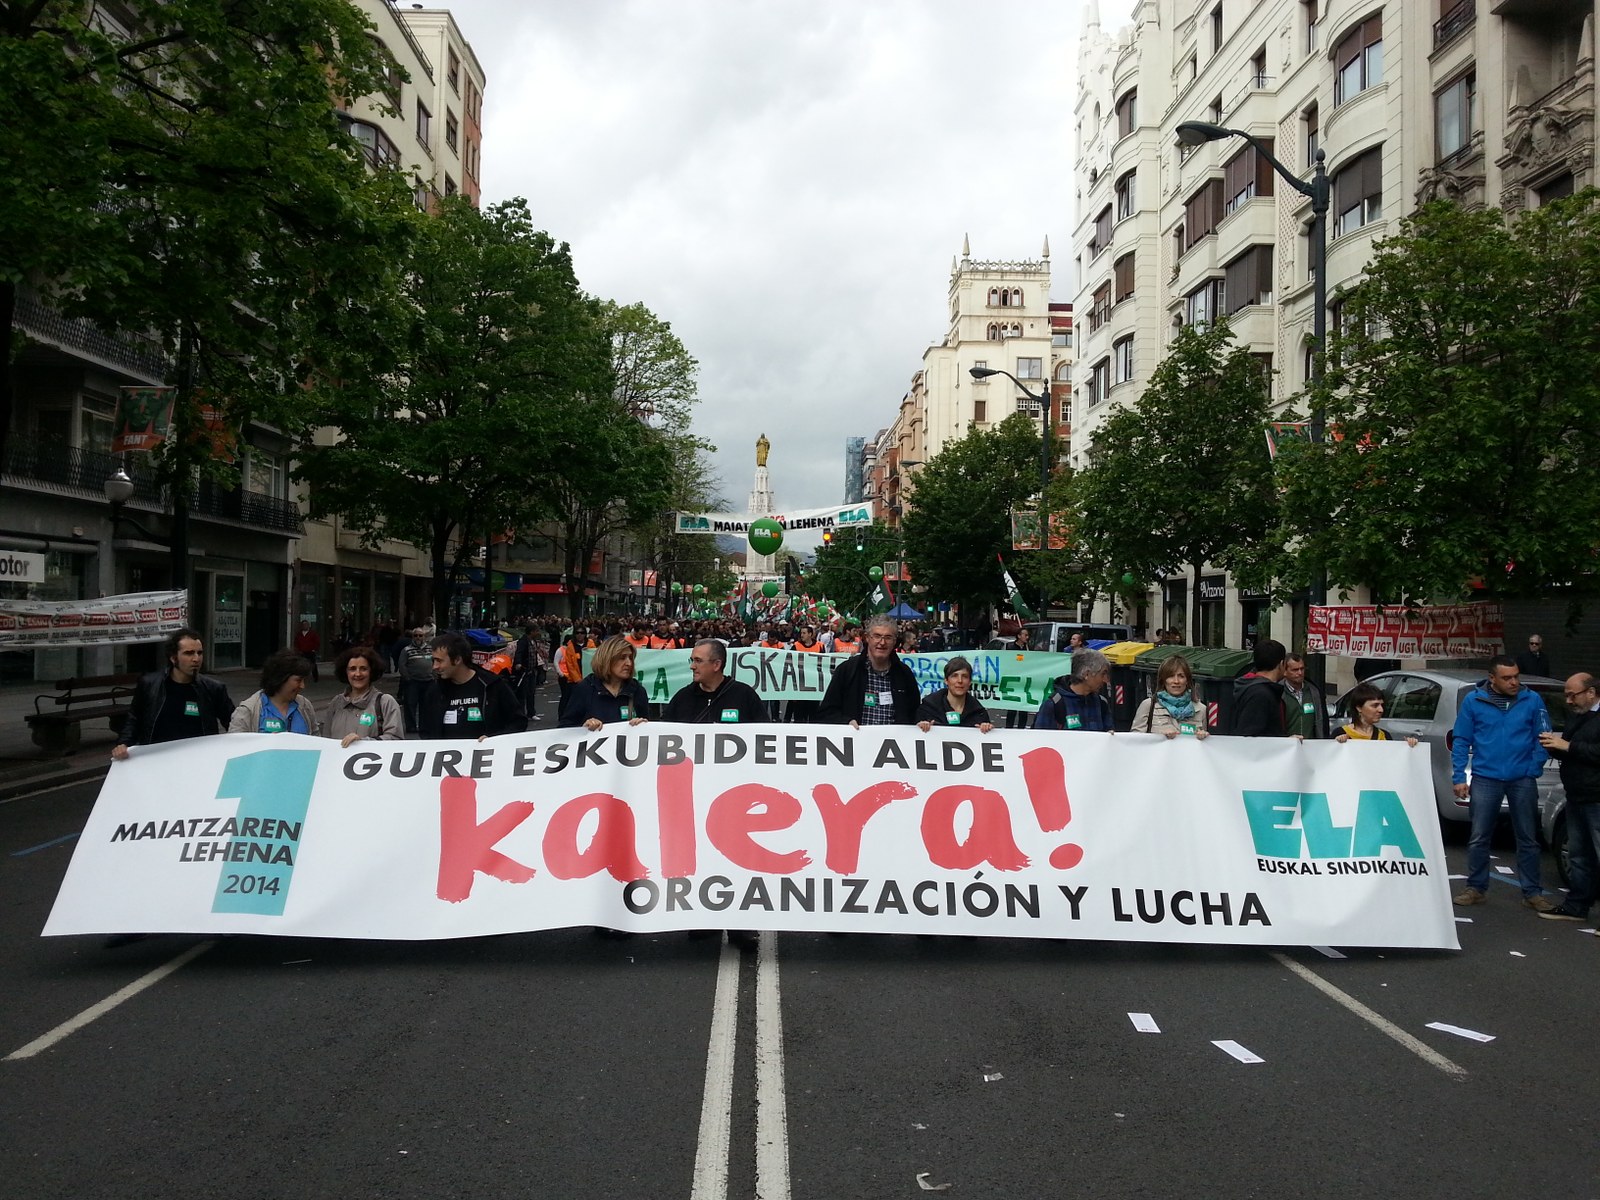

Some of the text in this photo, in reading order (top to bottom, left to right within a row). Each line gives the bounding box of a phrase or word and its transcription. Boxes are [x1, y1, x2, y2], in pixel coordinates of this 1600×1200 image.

[790, 517, 835, 529] LEHENA
[839, 508, 870, 522] ELA
[1308, 639, 1321, 648] GT
[1329, 639, 1344, 650] UGT
[1352, 640, 1367, 652] UGT
[1375, 641, 1391, 652] UGT
[1399, 642, 1416, 654] UGT
[1424, 643, 1441, 654] UGT
[343, 734, 1005, 780] GURE ESKUBIDEEN ALDE
[110, 817, 301, 842] MAIATZAREN
[211, 749, 322, 917] 1
[436, 747, 1084, 904] kalera!
[1242, 790, 1425, 859] ELA
[179, 841, 294, 866] LEHENA
[1257, 858, 1429, 877] EUSKAL SINDIKATUA
[223, 874, 280, 896] 2014
[622, 871, 1272, 926] ORGANIZACIÓN Y LUCHA
